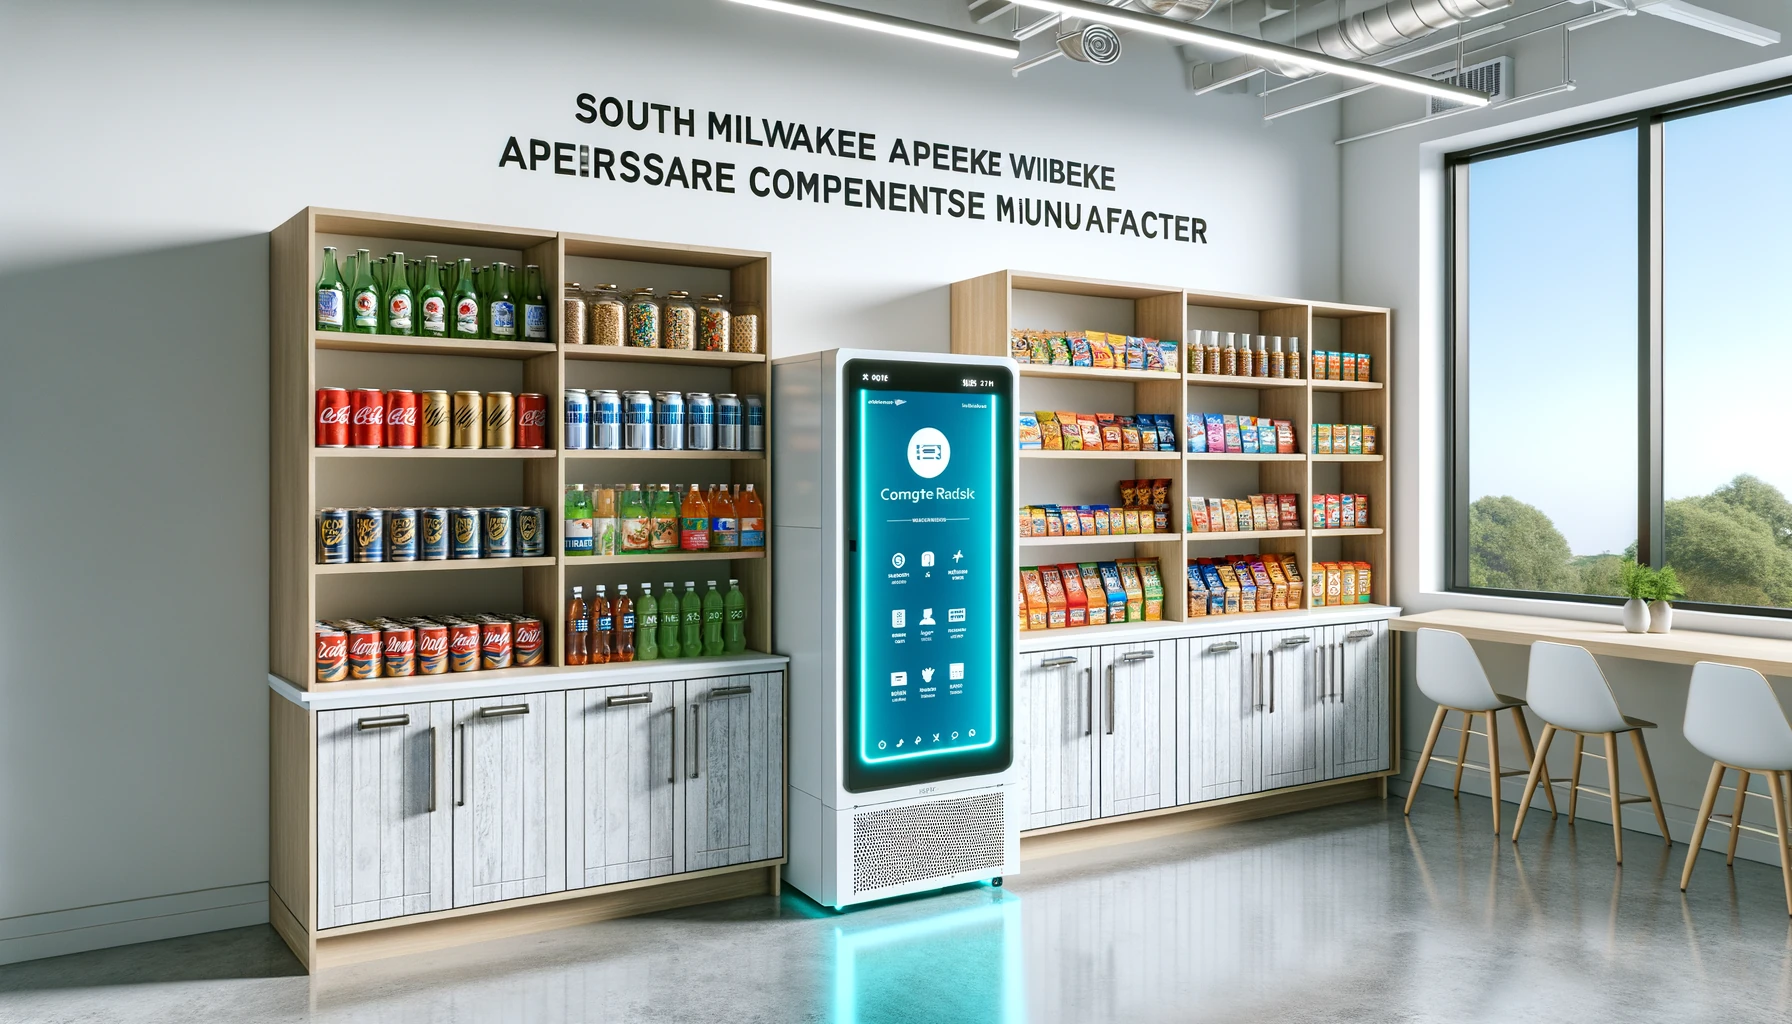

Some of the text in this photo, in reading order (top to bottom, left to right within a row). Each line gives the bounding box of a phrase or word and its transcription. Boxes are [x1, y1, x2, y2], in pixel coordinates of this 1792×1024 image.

[575, 92, 695, 138] SOUTH
[708, 111, 877, 161] MILWAKEE
[888, 138, 1002, 177] APEEKE
[749, 166, 985, 220] COMPENENTSE
[880, 487, 975, 503] Comgte Radsk
